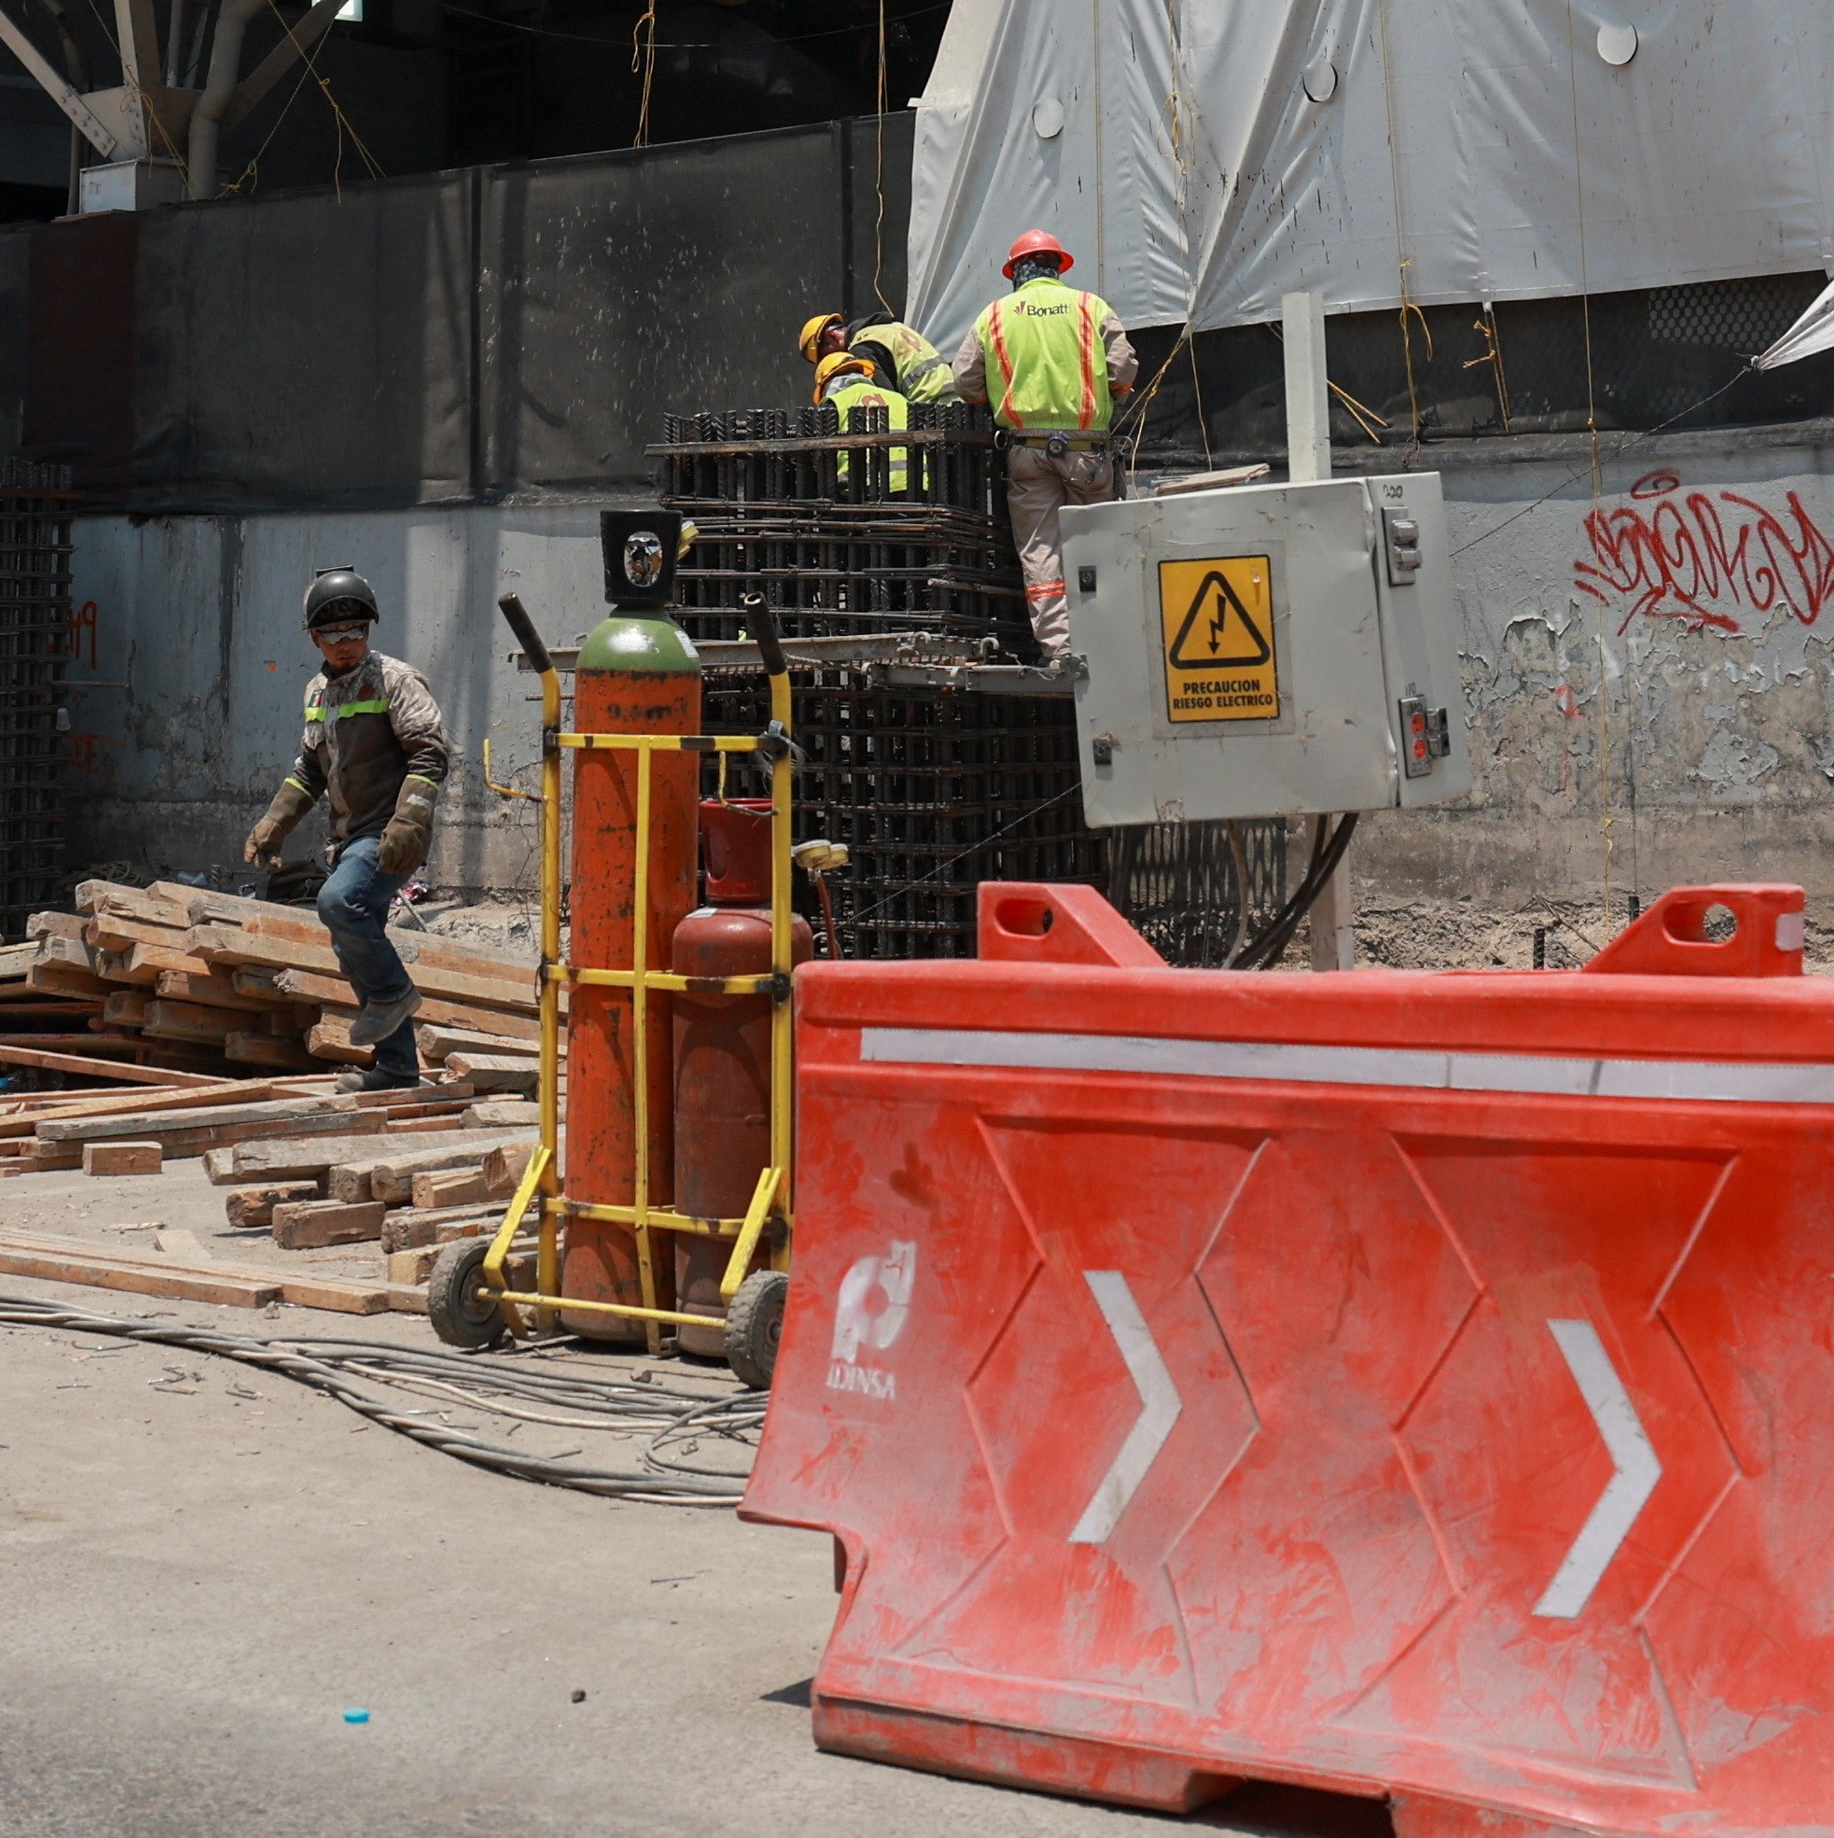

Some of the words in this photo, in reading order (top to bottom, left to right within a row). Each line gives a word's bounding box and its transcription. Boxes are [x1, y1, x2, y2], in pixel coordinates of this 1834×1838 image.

[1183, 679, 1260, 694] PRECAUCION
[1173, 696, 1212, 709] RIESGO
[1216, 694, 1273, 708] ELECTRICO
